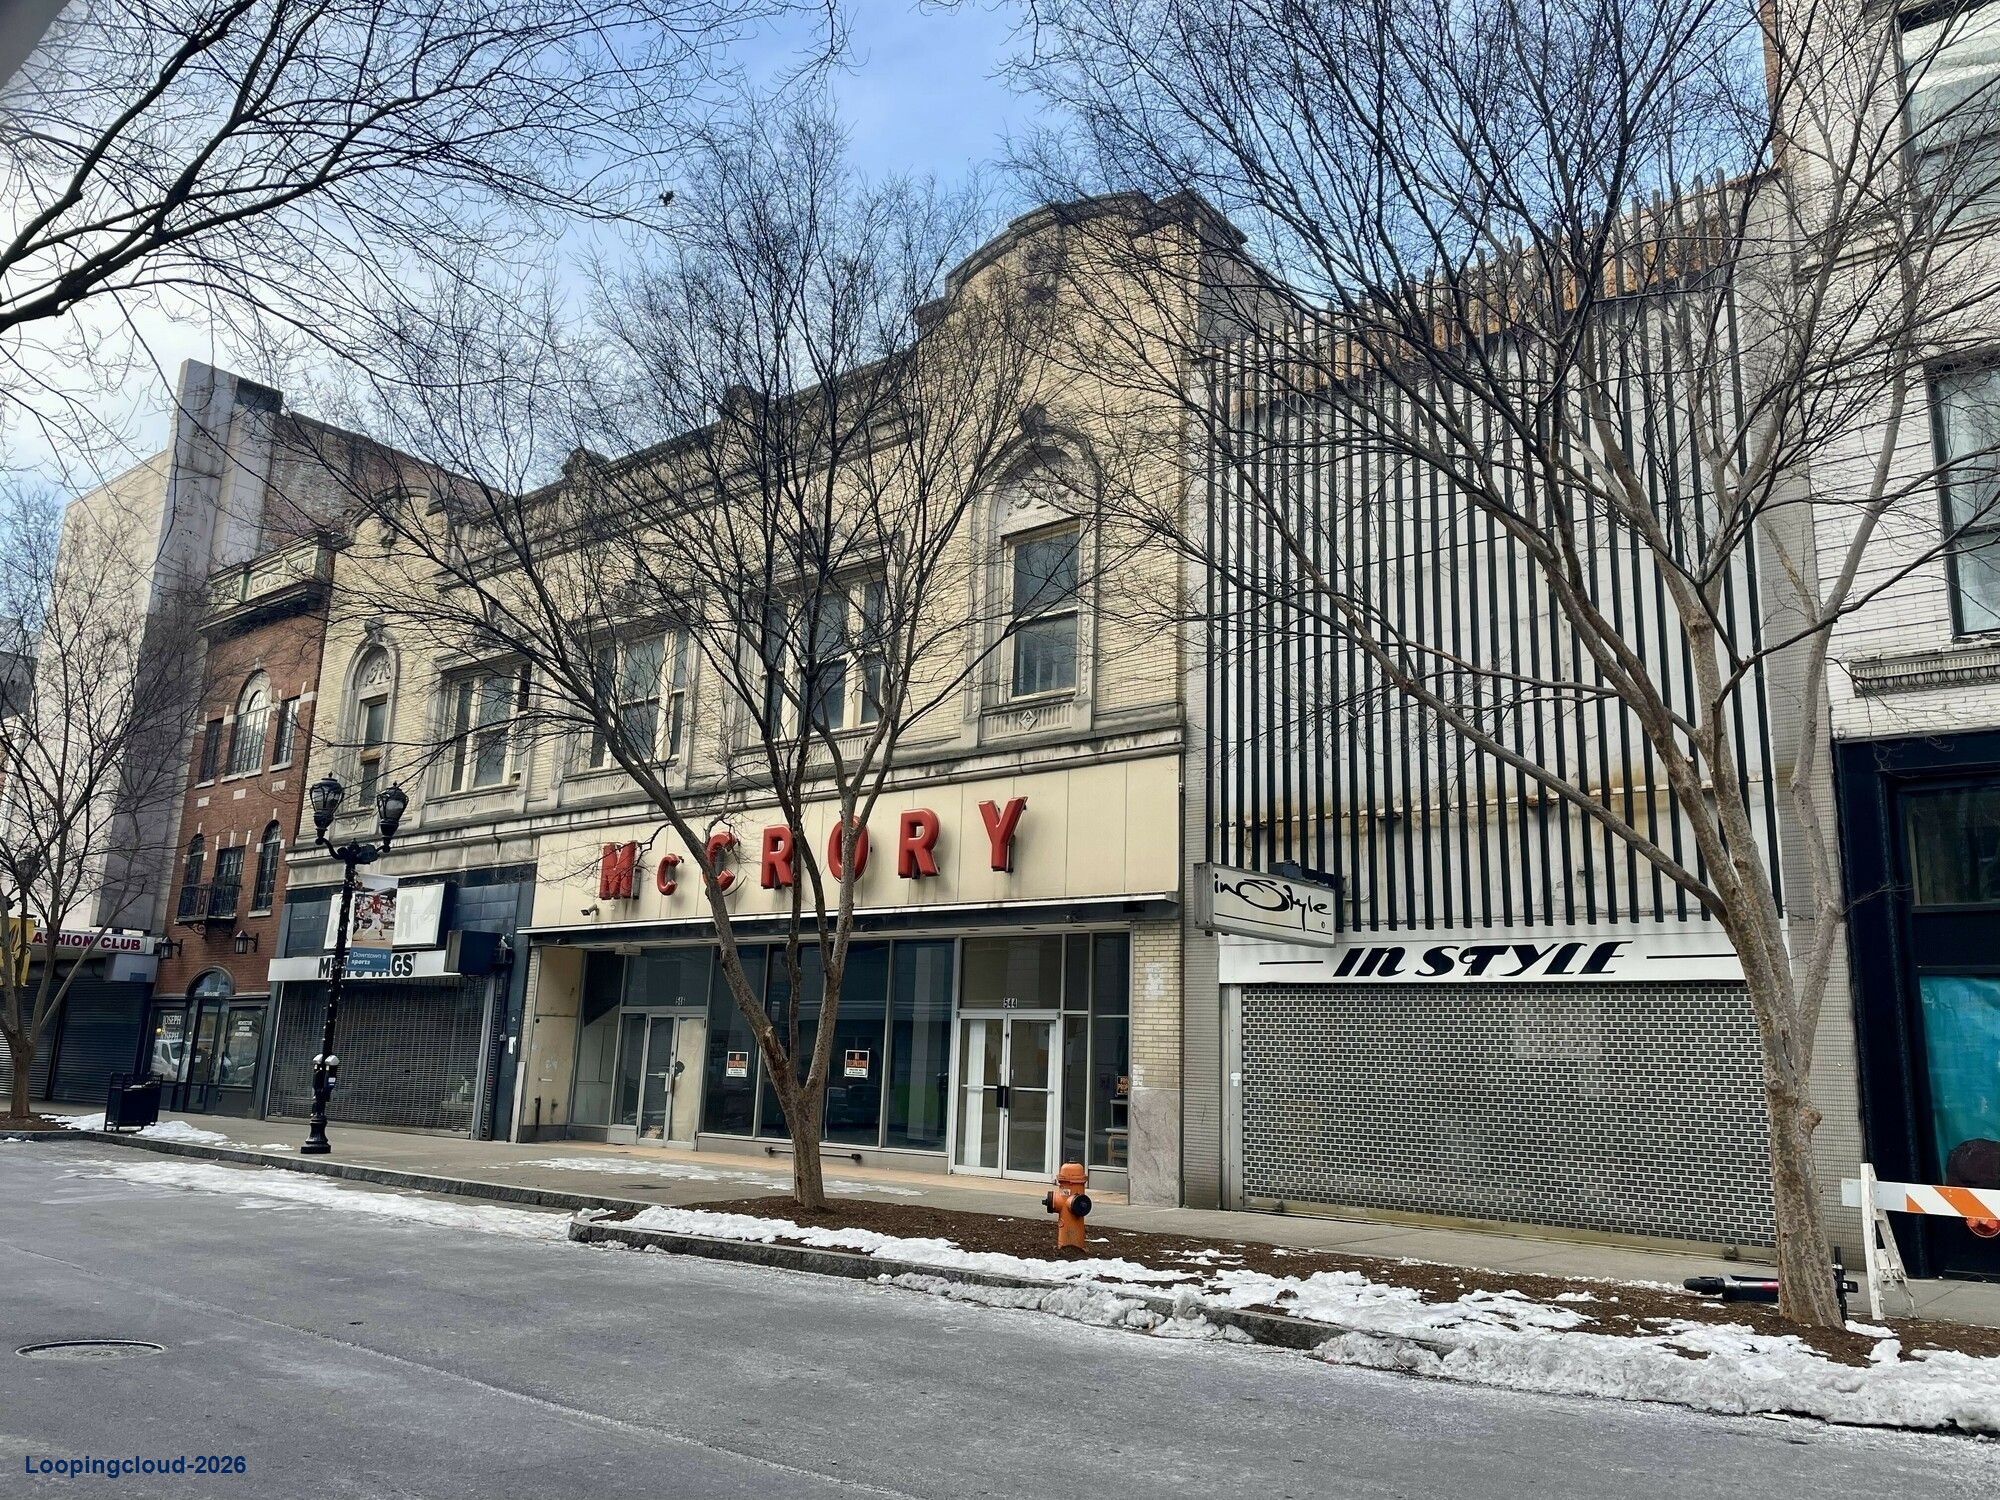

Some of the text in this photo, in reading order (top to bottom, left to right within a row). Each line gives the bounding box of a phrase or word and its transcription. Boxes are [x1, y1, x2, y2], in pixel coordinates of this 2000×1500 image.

[32, 931, 141, 951] AHION CLUB
[1414, 941, 1634, 977] STYLE
